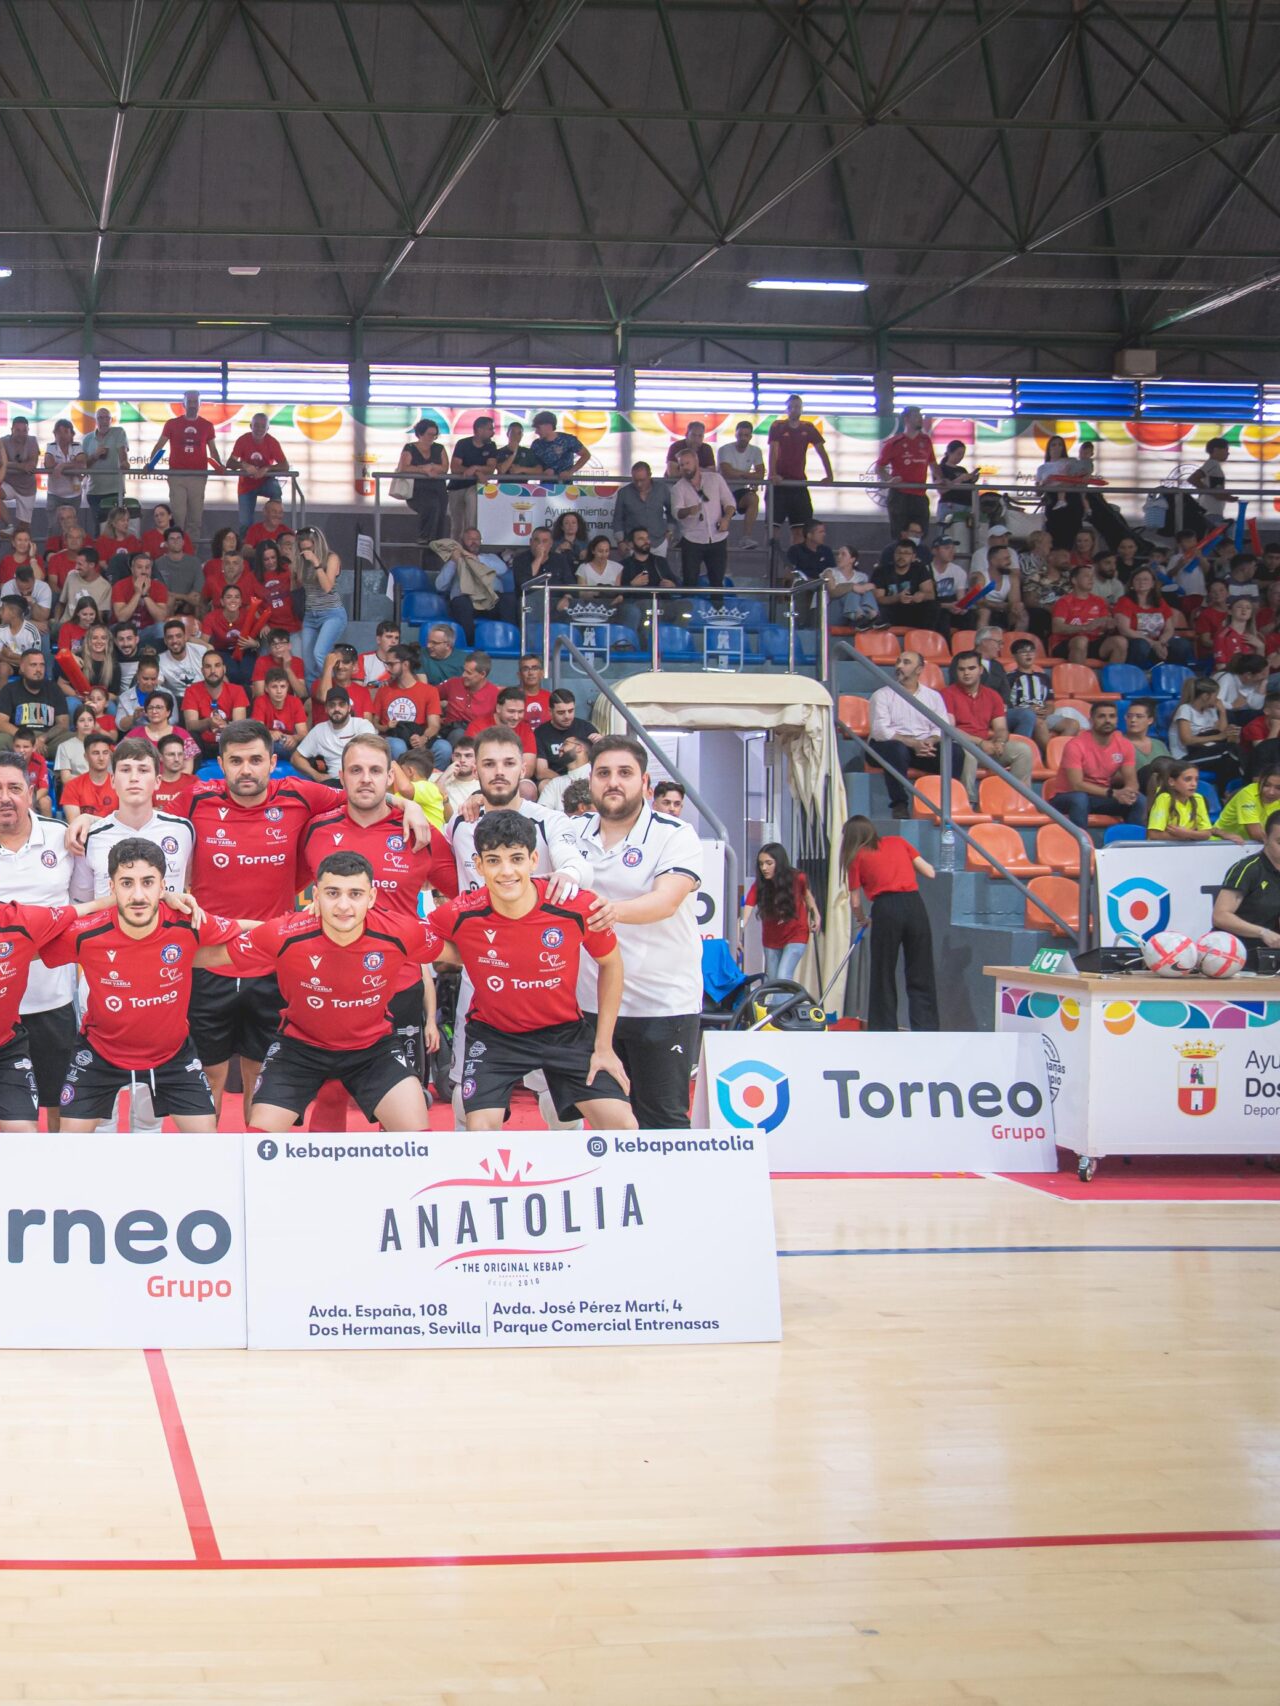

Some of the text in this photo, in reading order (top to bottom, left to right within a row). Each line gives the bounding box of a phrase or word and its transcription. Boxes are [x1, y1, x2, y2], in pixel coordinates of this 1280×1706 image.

[237, 853, 286, 866] Torneo
[372, 880, 398, 889] neo
[511, 977, 562, 990] Torneo
[129, 990, 178, 1008] Torneo
[331, 994, 381, 1009] Torneo
[1047, 1062, 1066, 1075] anas
[823, 1069, 1044, 1120] Torneo
[991, 1124, 1047, 1143] Grupo
[284, 1141, 429, 1163] kebapanatolia
[614, 1135, 755, 1157] kebapanatolia
[378, 1182, 645, 1253] ANATOLIA
[462, 1261, 564, 1273] THE ORIGINAL KEBAP
[146, 1275, 232, 1303] Grupo
[309, 1302, 448, 1322] Avda. España, 108
[492, 1299, 683, 1315] Avda. José Pérez Martí, 4
[309, 1321, 481, 1337] Dos Hermanas, Sevilla
[492, 1316, 720, 1337] Parque Comercial Entrenasas
